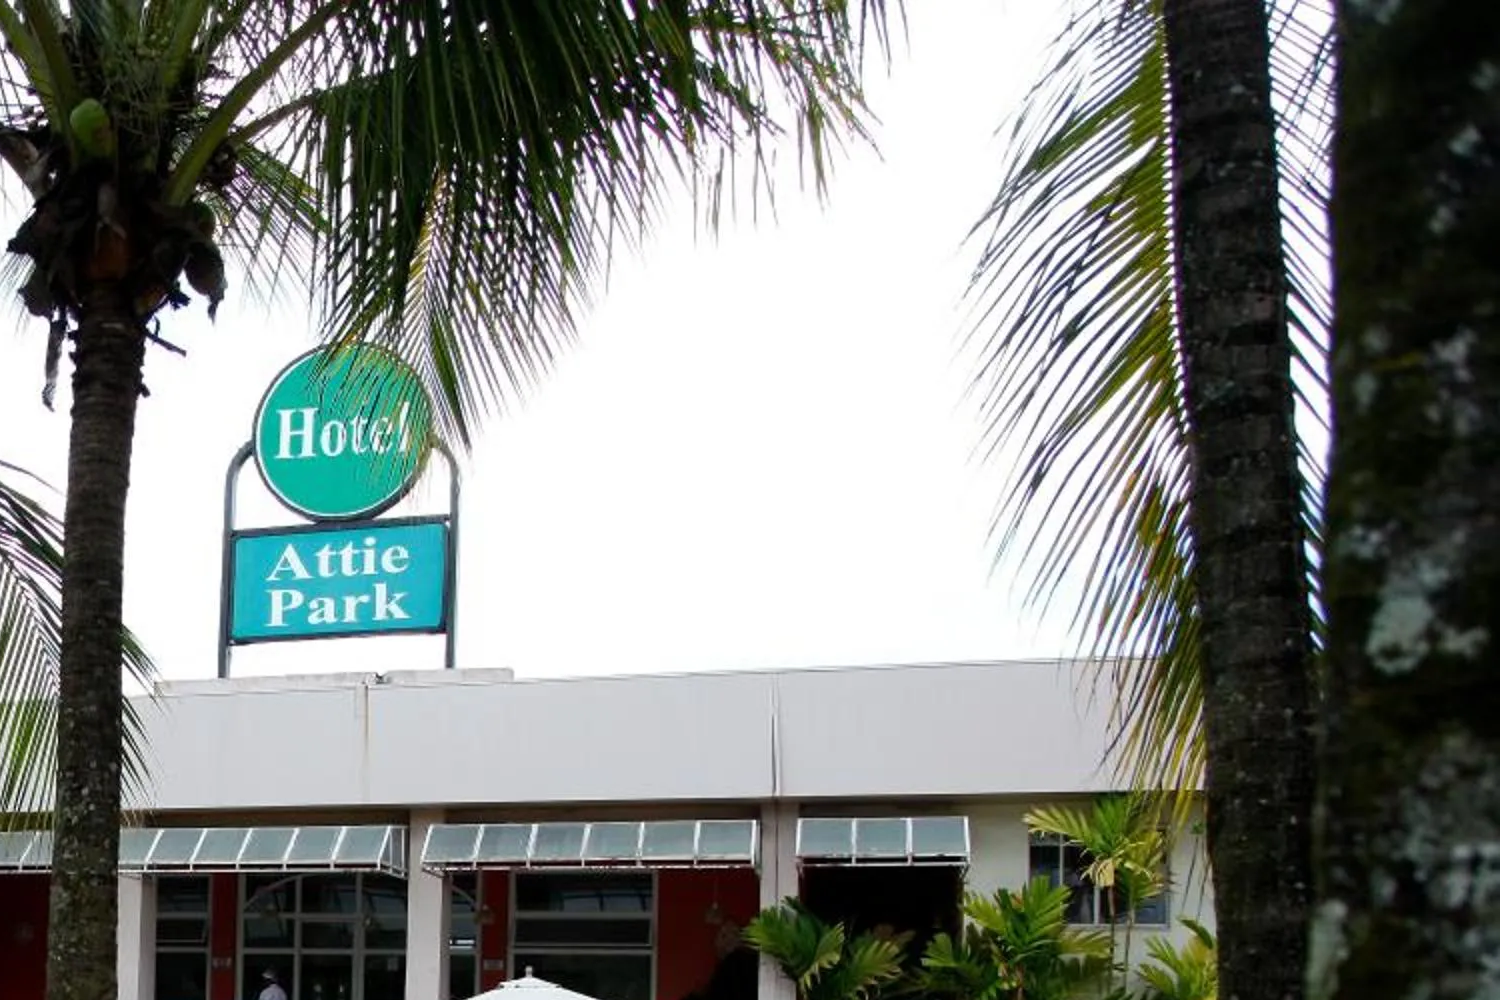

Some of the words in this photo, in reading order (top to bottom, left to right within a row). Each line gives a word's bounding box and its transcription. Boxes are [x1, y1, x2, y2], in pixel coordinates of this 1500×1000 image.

[275, 401, 411, 459] Hotel
[266, 537, 409, 581] Attie
[265, 582, 411, 627] Park
